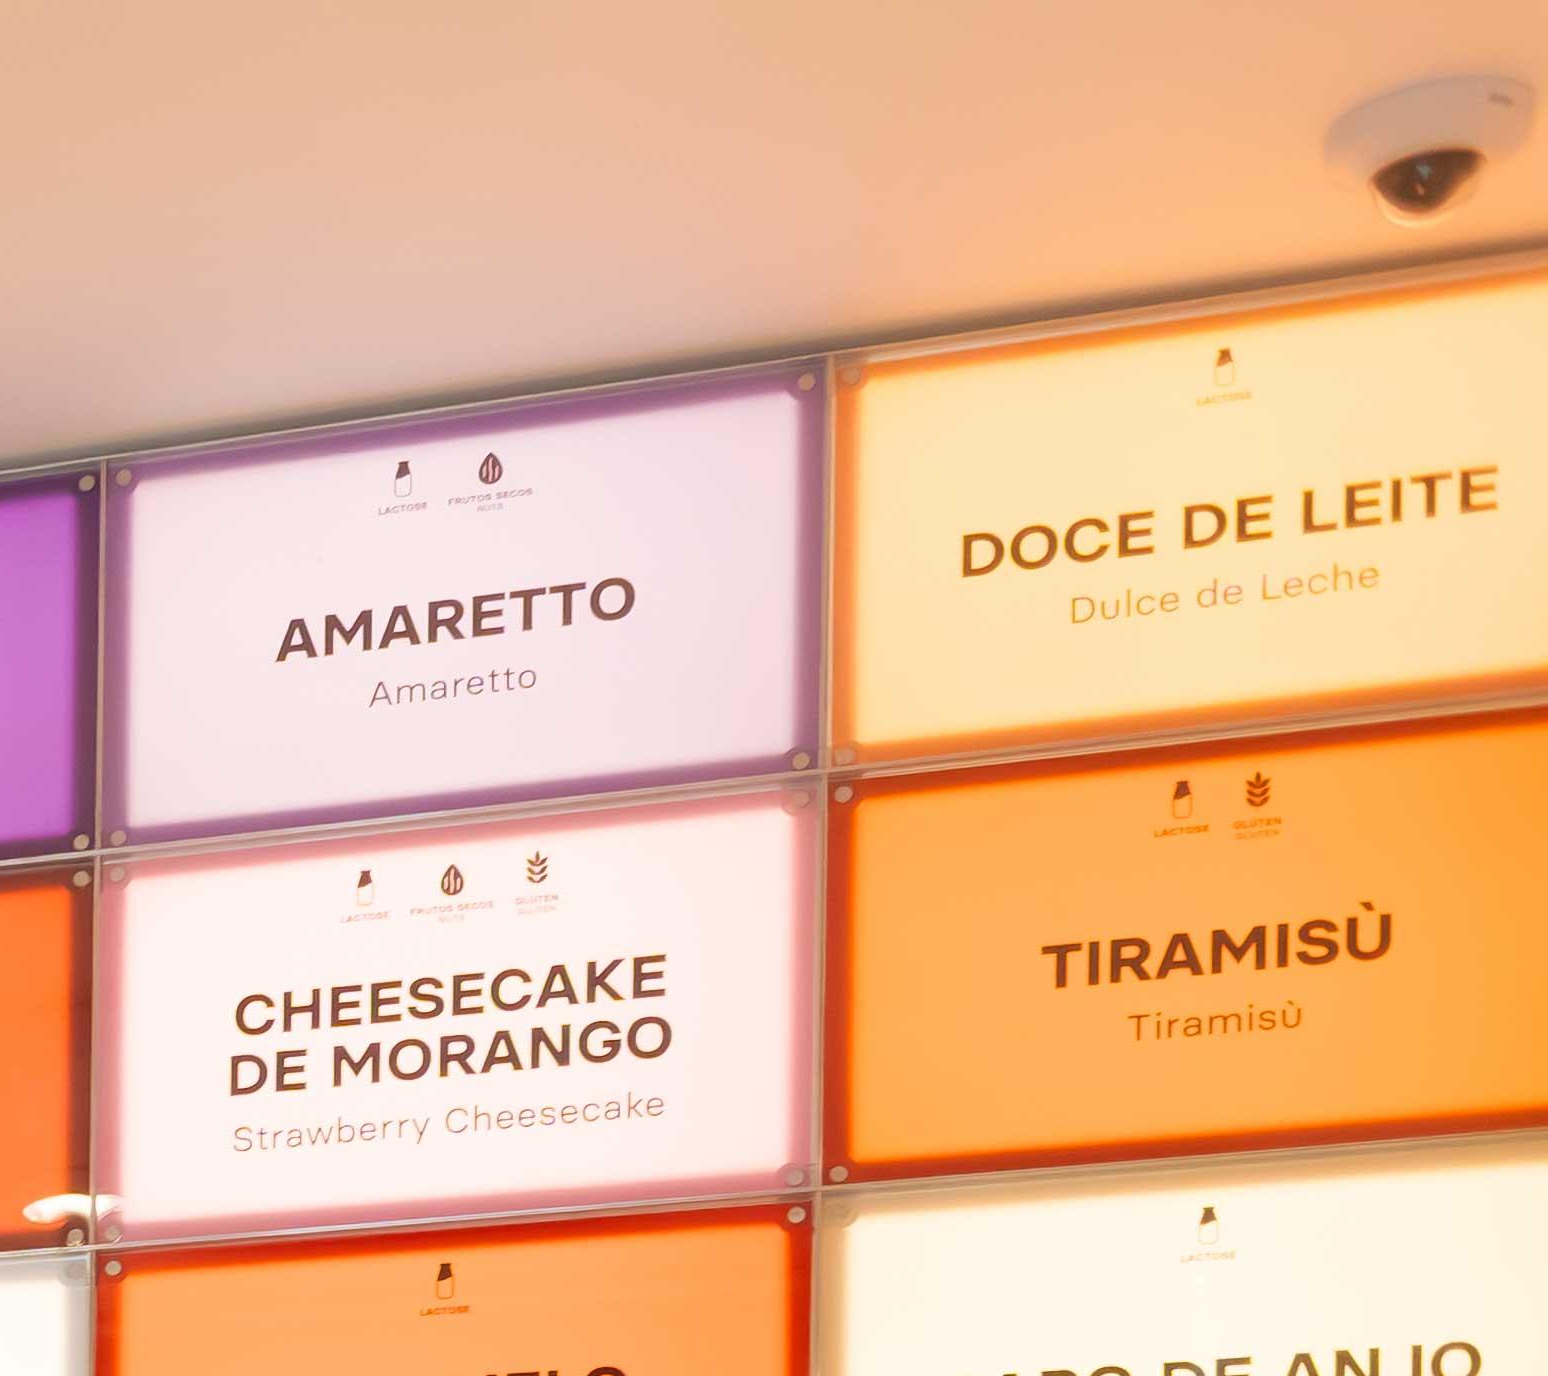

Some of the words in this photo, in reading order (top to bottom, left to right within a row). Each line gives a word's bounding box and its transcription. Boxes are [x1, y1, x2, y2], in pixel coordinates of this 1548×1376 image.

[963, 511, 1153, 577] DOCE
[1184, 496, 1272, 549] DE
[1300, 467, 1497, 536] LEITE
[275, 578, 635, 662] AMARETTO
[1068, 583, 1179, 624] Dulce
[1194, 578, 1243, 608] de
[1260, 558, 1380, 601] Leche
[368, 664, 536, 707] Amaretto
[1042, 900, 1391, 988] TIRAMISÙ
[234, 954, 671, 1038] CHEESECAKE
[1127, 1000, 1301, 1041] Tiramisù
[228, 1049, 306, 1096] DE
[332, 1017, 671, 1086] MORANGO
[231, 1110, 430, 1151] Strawberry
[444, 1089, 664, 1133] Cheesecake
